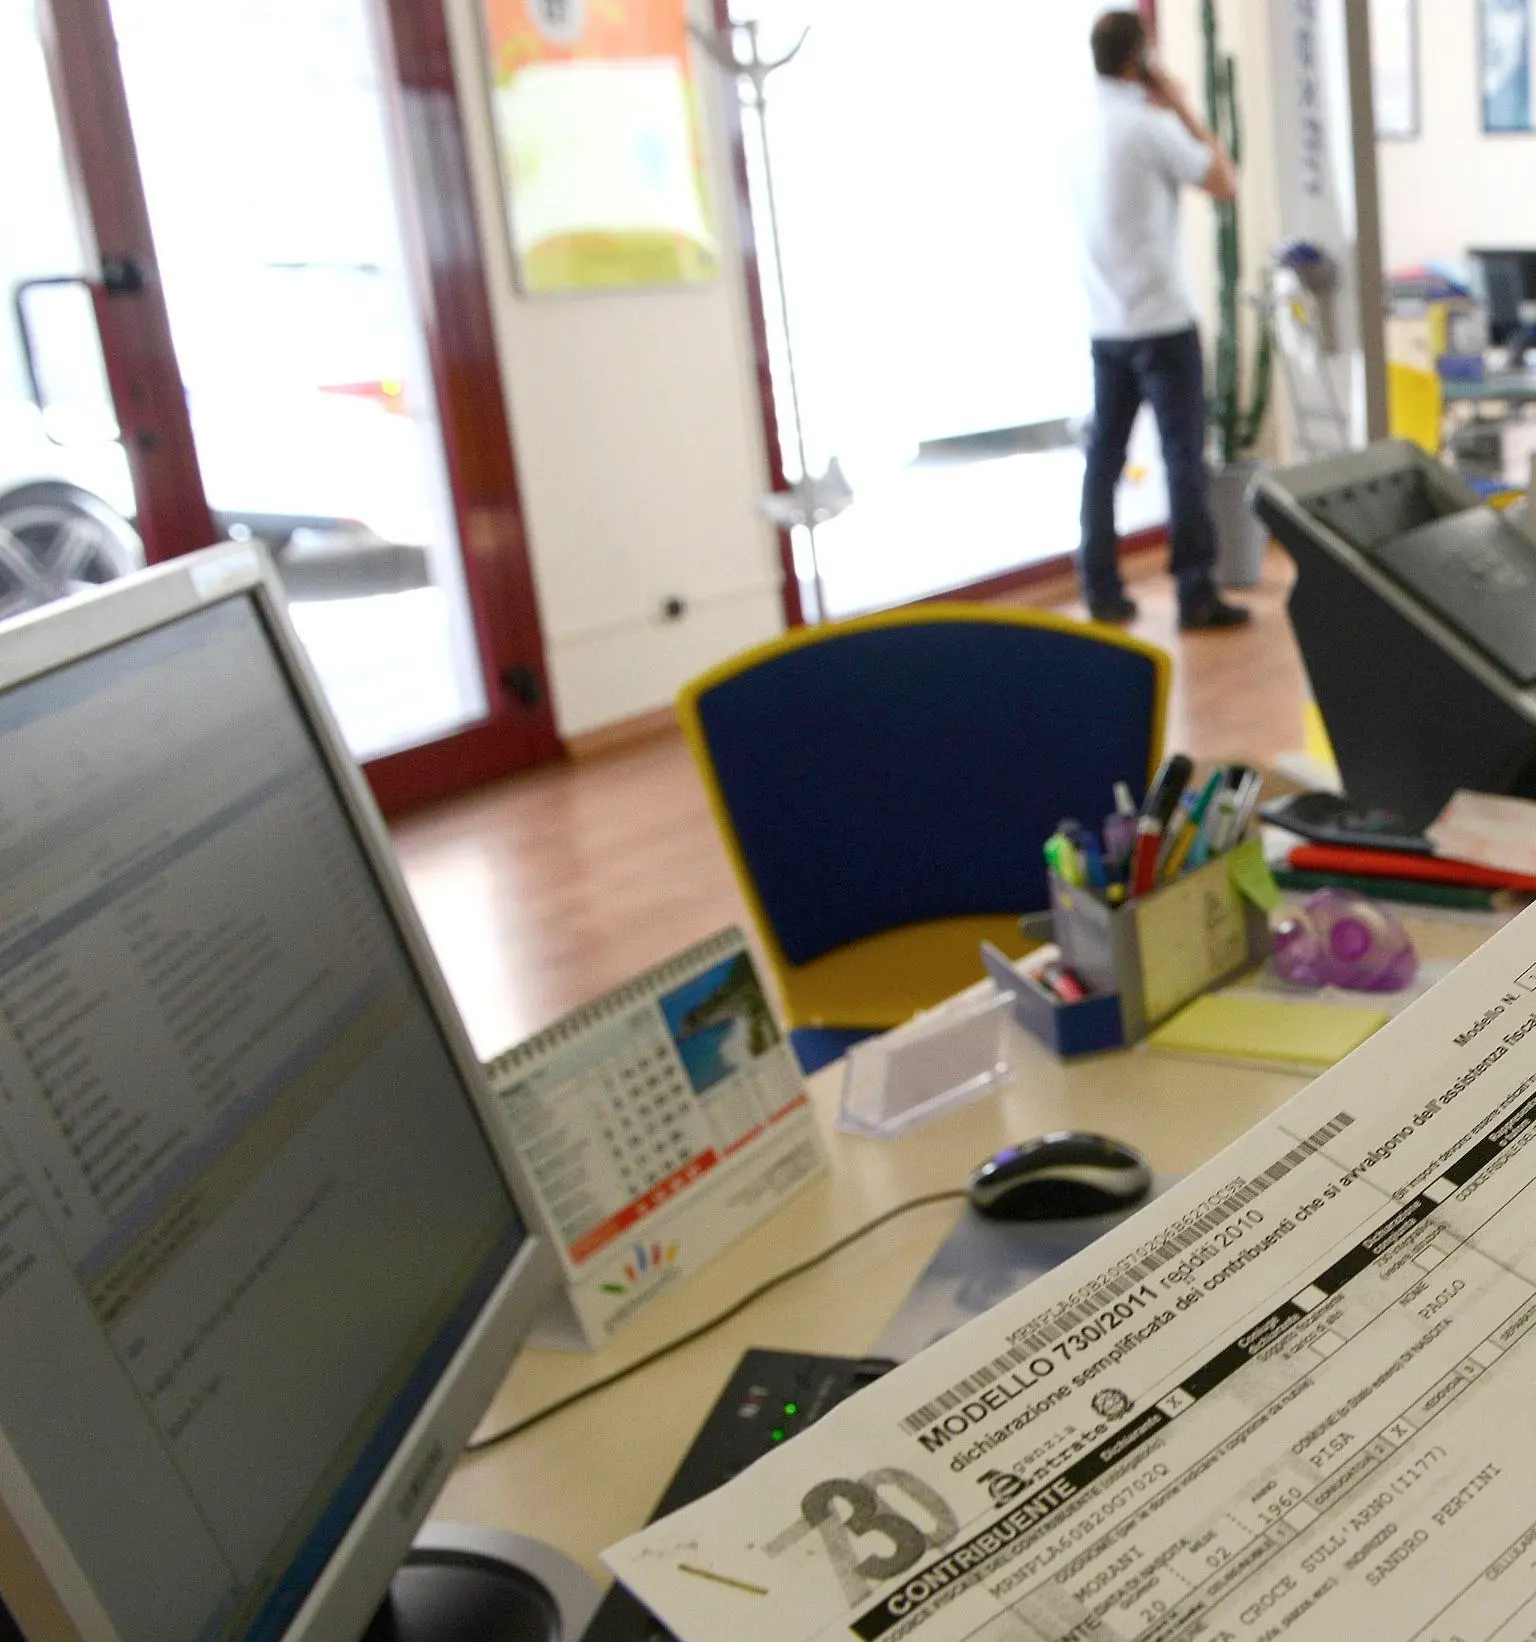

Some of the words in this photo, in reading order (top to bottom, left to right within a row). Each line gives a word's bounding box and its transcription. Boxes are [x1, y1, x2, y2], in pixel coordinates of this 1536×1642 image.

[1451, 1003, 1508, 1047] Modello
[944, 1381, 1074, 1475] dichiarazione
[1065, 1307, 1178, 1388] semplificata
[1170, 1285, 1206, 1313] dei
[1197, 1216, 1297, 1292] contribuenti
[1287, 1193, 1327, 1223] che
[1316, 1181, 1343, 1200] si
[1332, 1123, 1419, 1188] avvalgono
[1408, 1042, 1509, 1127] dell'assistenza
[1416, 1277, 1468, 1321] PAOLO
[915, 1353, 1058, 1455] MODELLO
[1048, 1283, 1159, 1361] 730/2011
[1209, 1207, 1269, 1248] 2010
[1307, 1428, 1357, 1469] PISA
[1389, 1421, 1410, 1439] X
[1254, 1485, 1305, 1526] 1960
[1363, 1526, 1432, 1588] SANDRO
[1429, 1461, 1504, 1527] PERTINI
[882, 1474, 1080, 1620] CONTRIBUENTE
[1203, 1543, 1234, 1570] 02
[1071, 1543, 1144, 1604] MORANI
[1137, 1595, 1170, 1625] 20
[1236, 1573, 1300, 1628] CROCE
